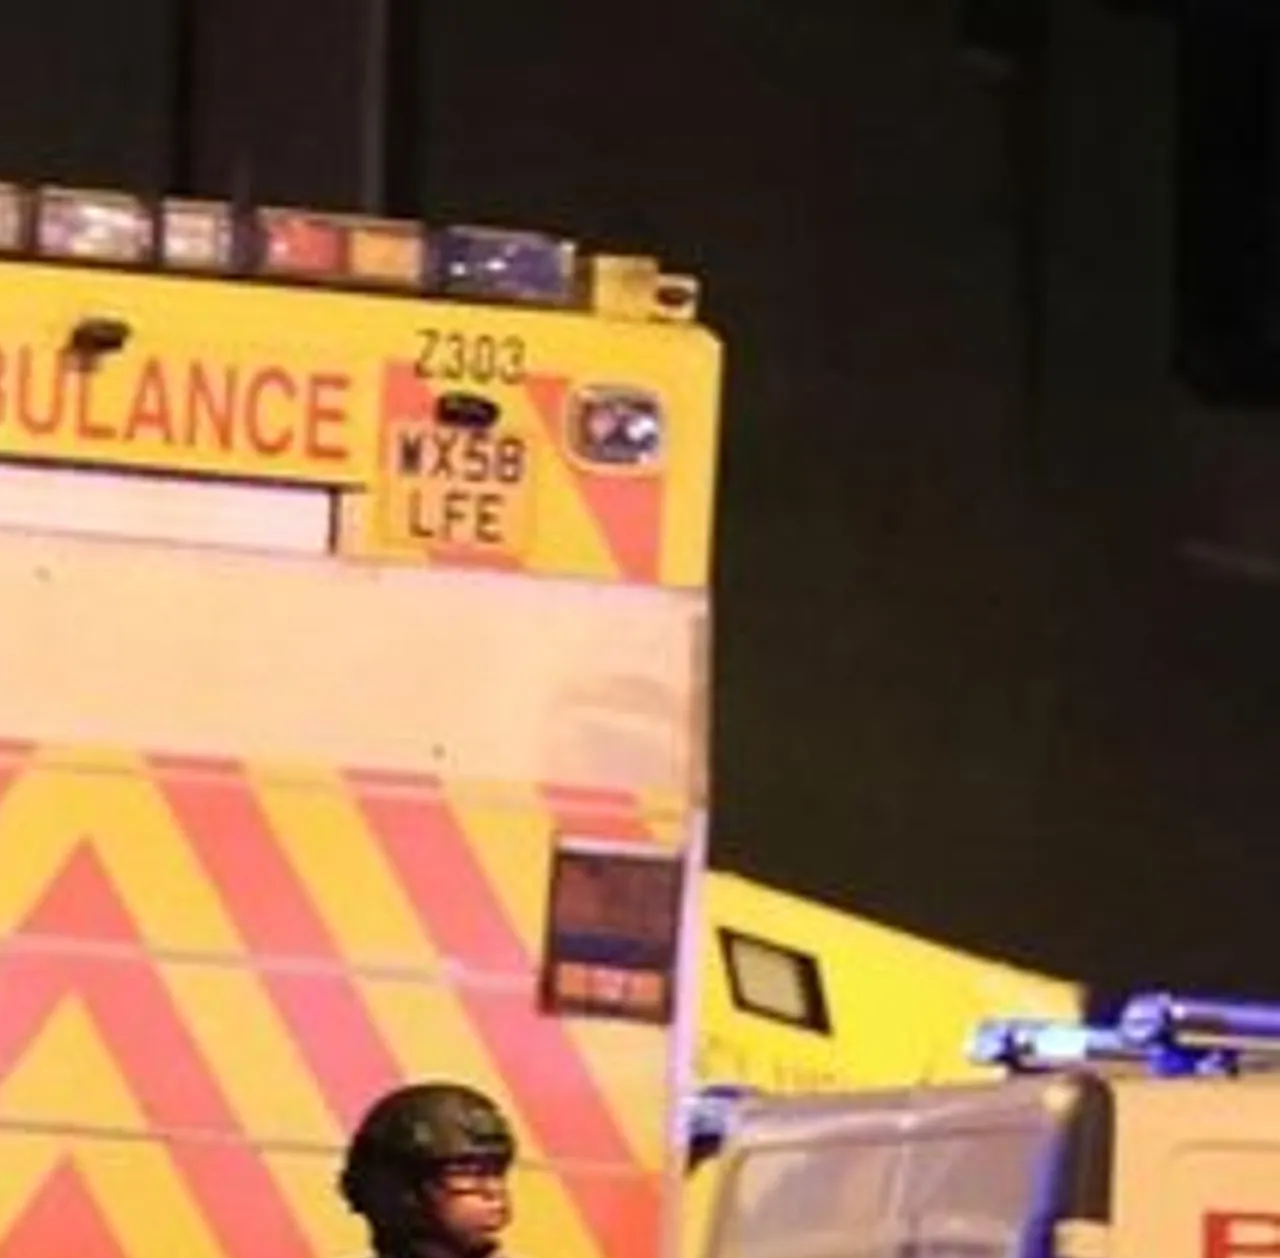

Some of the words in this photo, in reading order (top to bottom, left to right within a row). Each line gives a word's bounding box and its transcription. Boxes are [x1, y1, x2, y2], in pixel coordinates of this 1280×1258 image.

[414, 329, 528, 385] Z303
[398, 426, 526, 485] WX58
[407, 487, 506, 544] LFE
